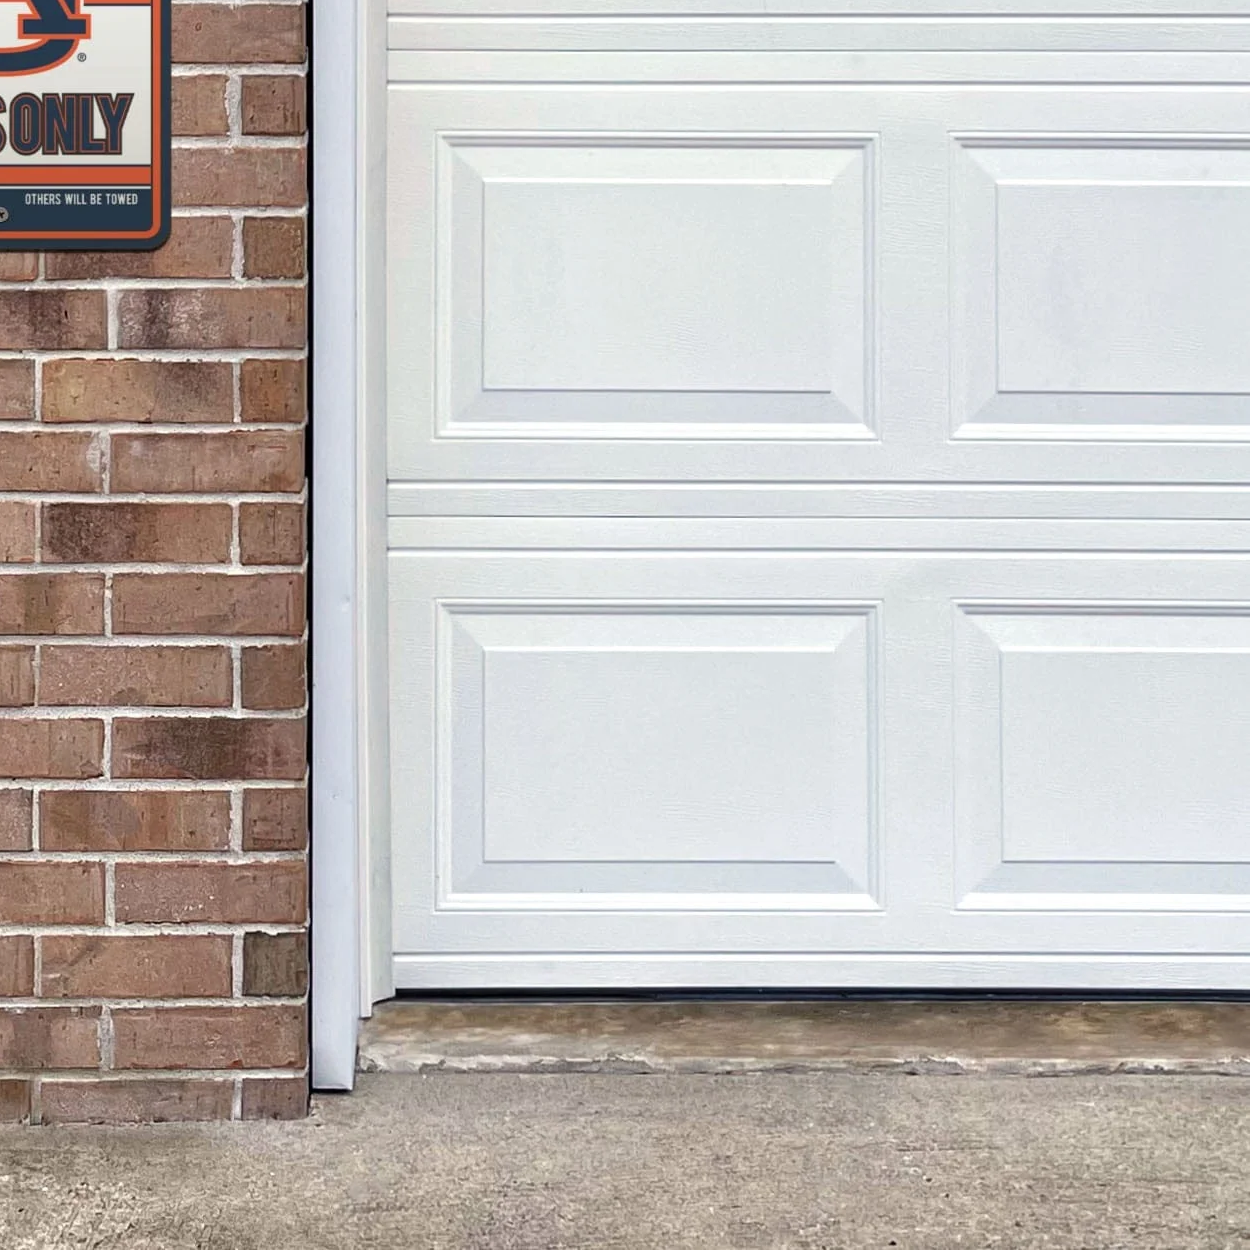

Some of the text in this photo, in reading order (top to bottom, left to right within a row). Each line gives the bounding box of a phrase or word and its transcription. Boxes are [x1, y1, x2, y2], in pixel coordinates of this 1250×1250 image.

[9, 92, 135, 155] ONLY
[24, 193, 138, 205] OTHERS WILL BE TOWED
